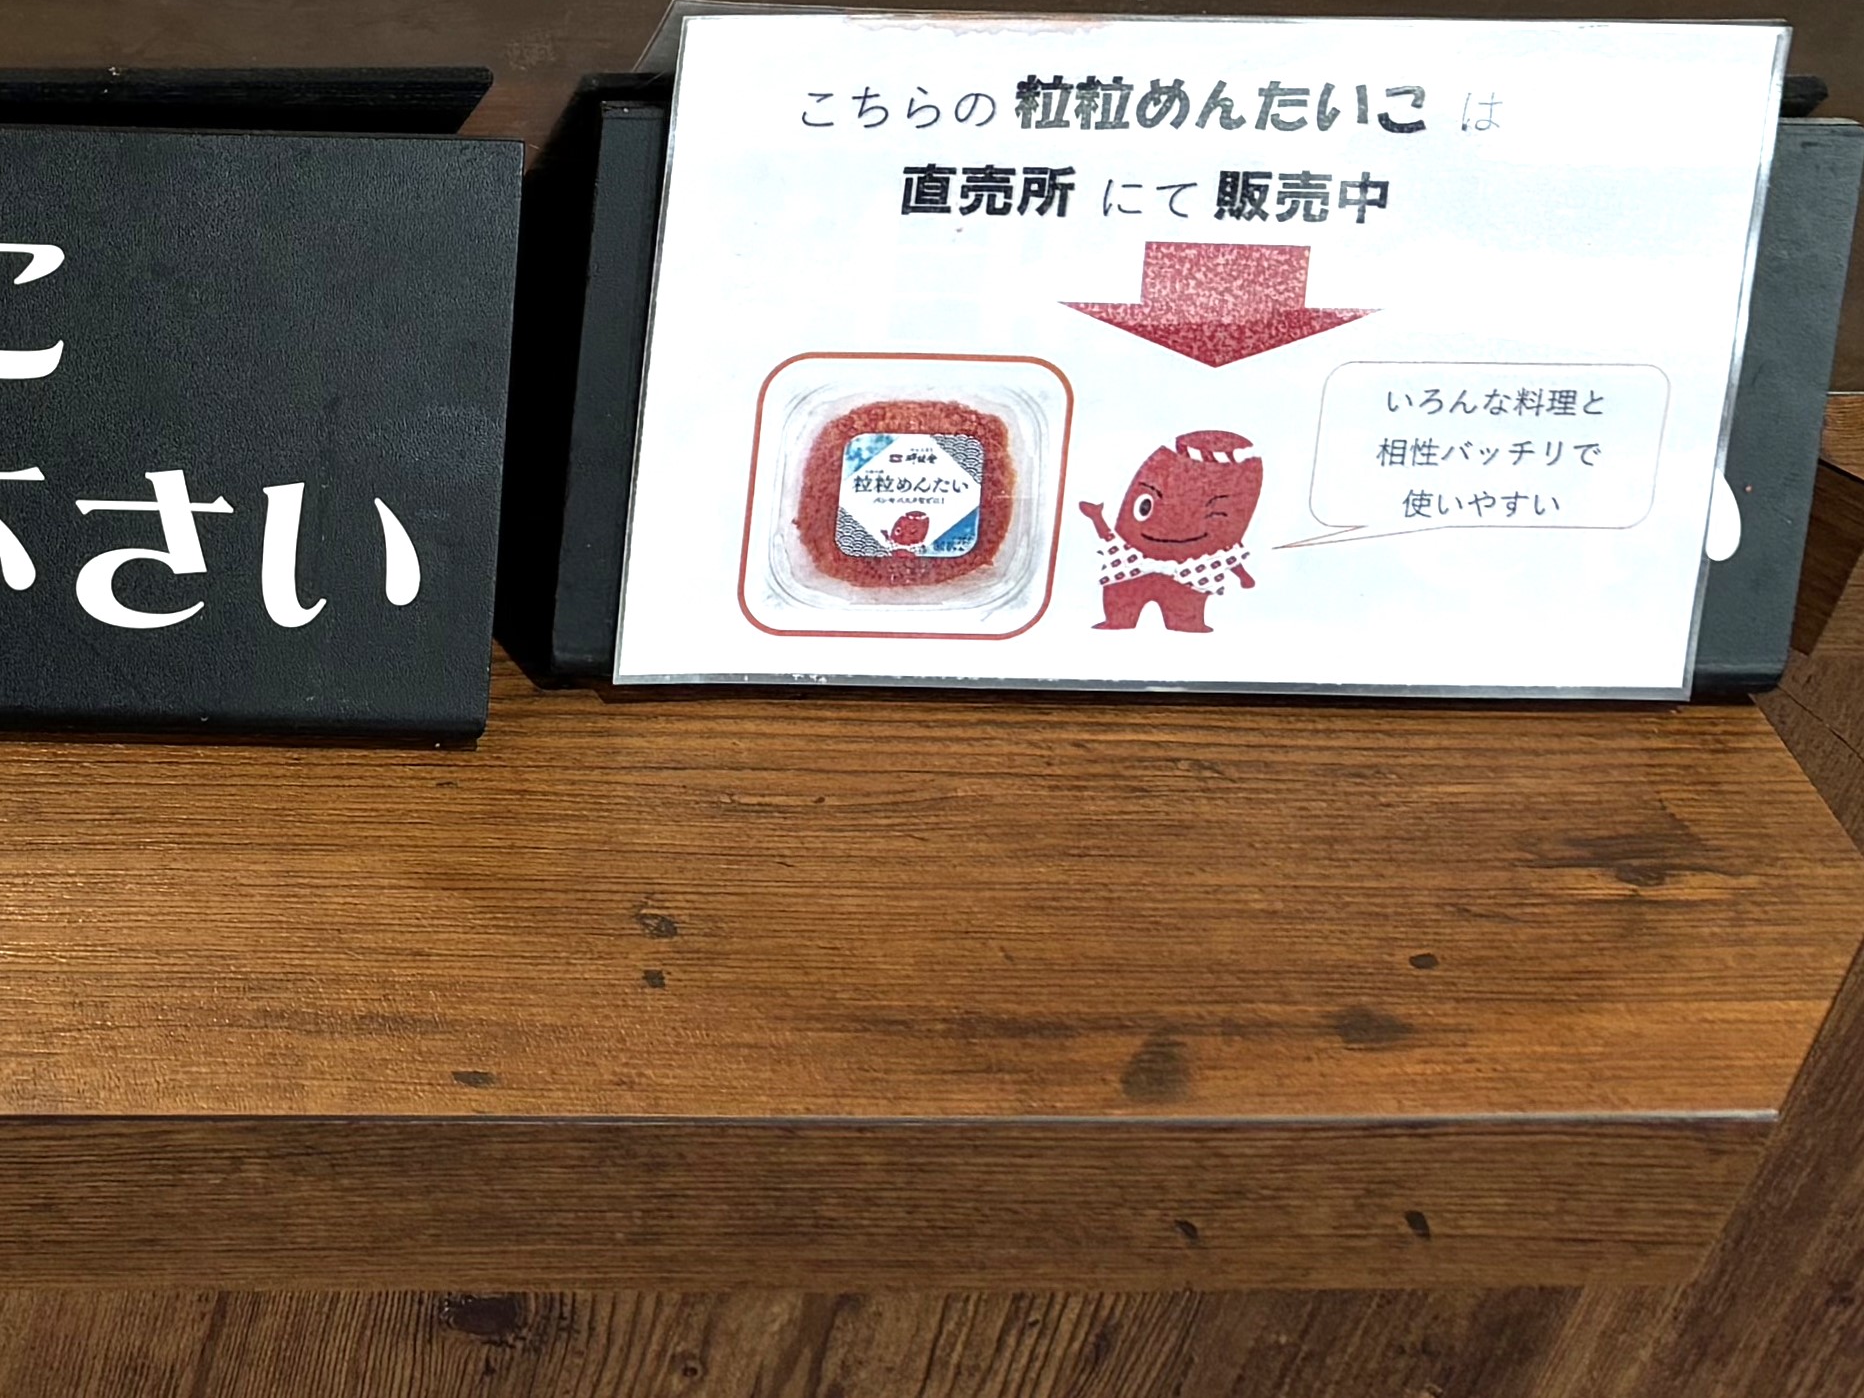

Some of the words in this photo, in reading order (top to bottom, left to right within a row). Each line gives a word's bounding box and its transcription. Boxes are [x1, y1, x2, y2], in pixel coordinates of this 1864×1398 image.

[799, 86, 997, 130] こちらの
[1014, 74, 1428, 135] 粒粒めんたいこ
[1459, 91, 1504, 133] は
[901, 164, 1077, 219] 直売所
[1101, 179, 1195, 220] にて
[1213, 171, 1391, 225] 販売中
[1387, 387, 1605, 417] いろんな料理と
[1376, 437, 1603, 467] 相性バッチリで
[852, 474, 969, 494] 粒粒めんたい
[1402, 488, 1562, 518] 使いやすい
